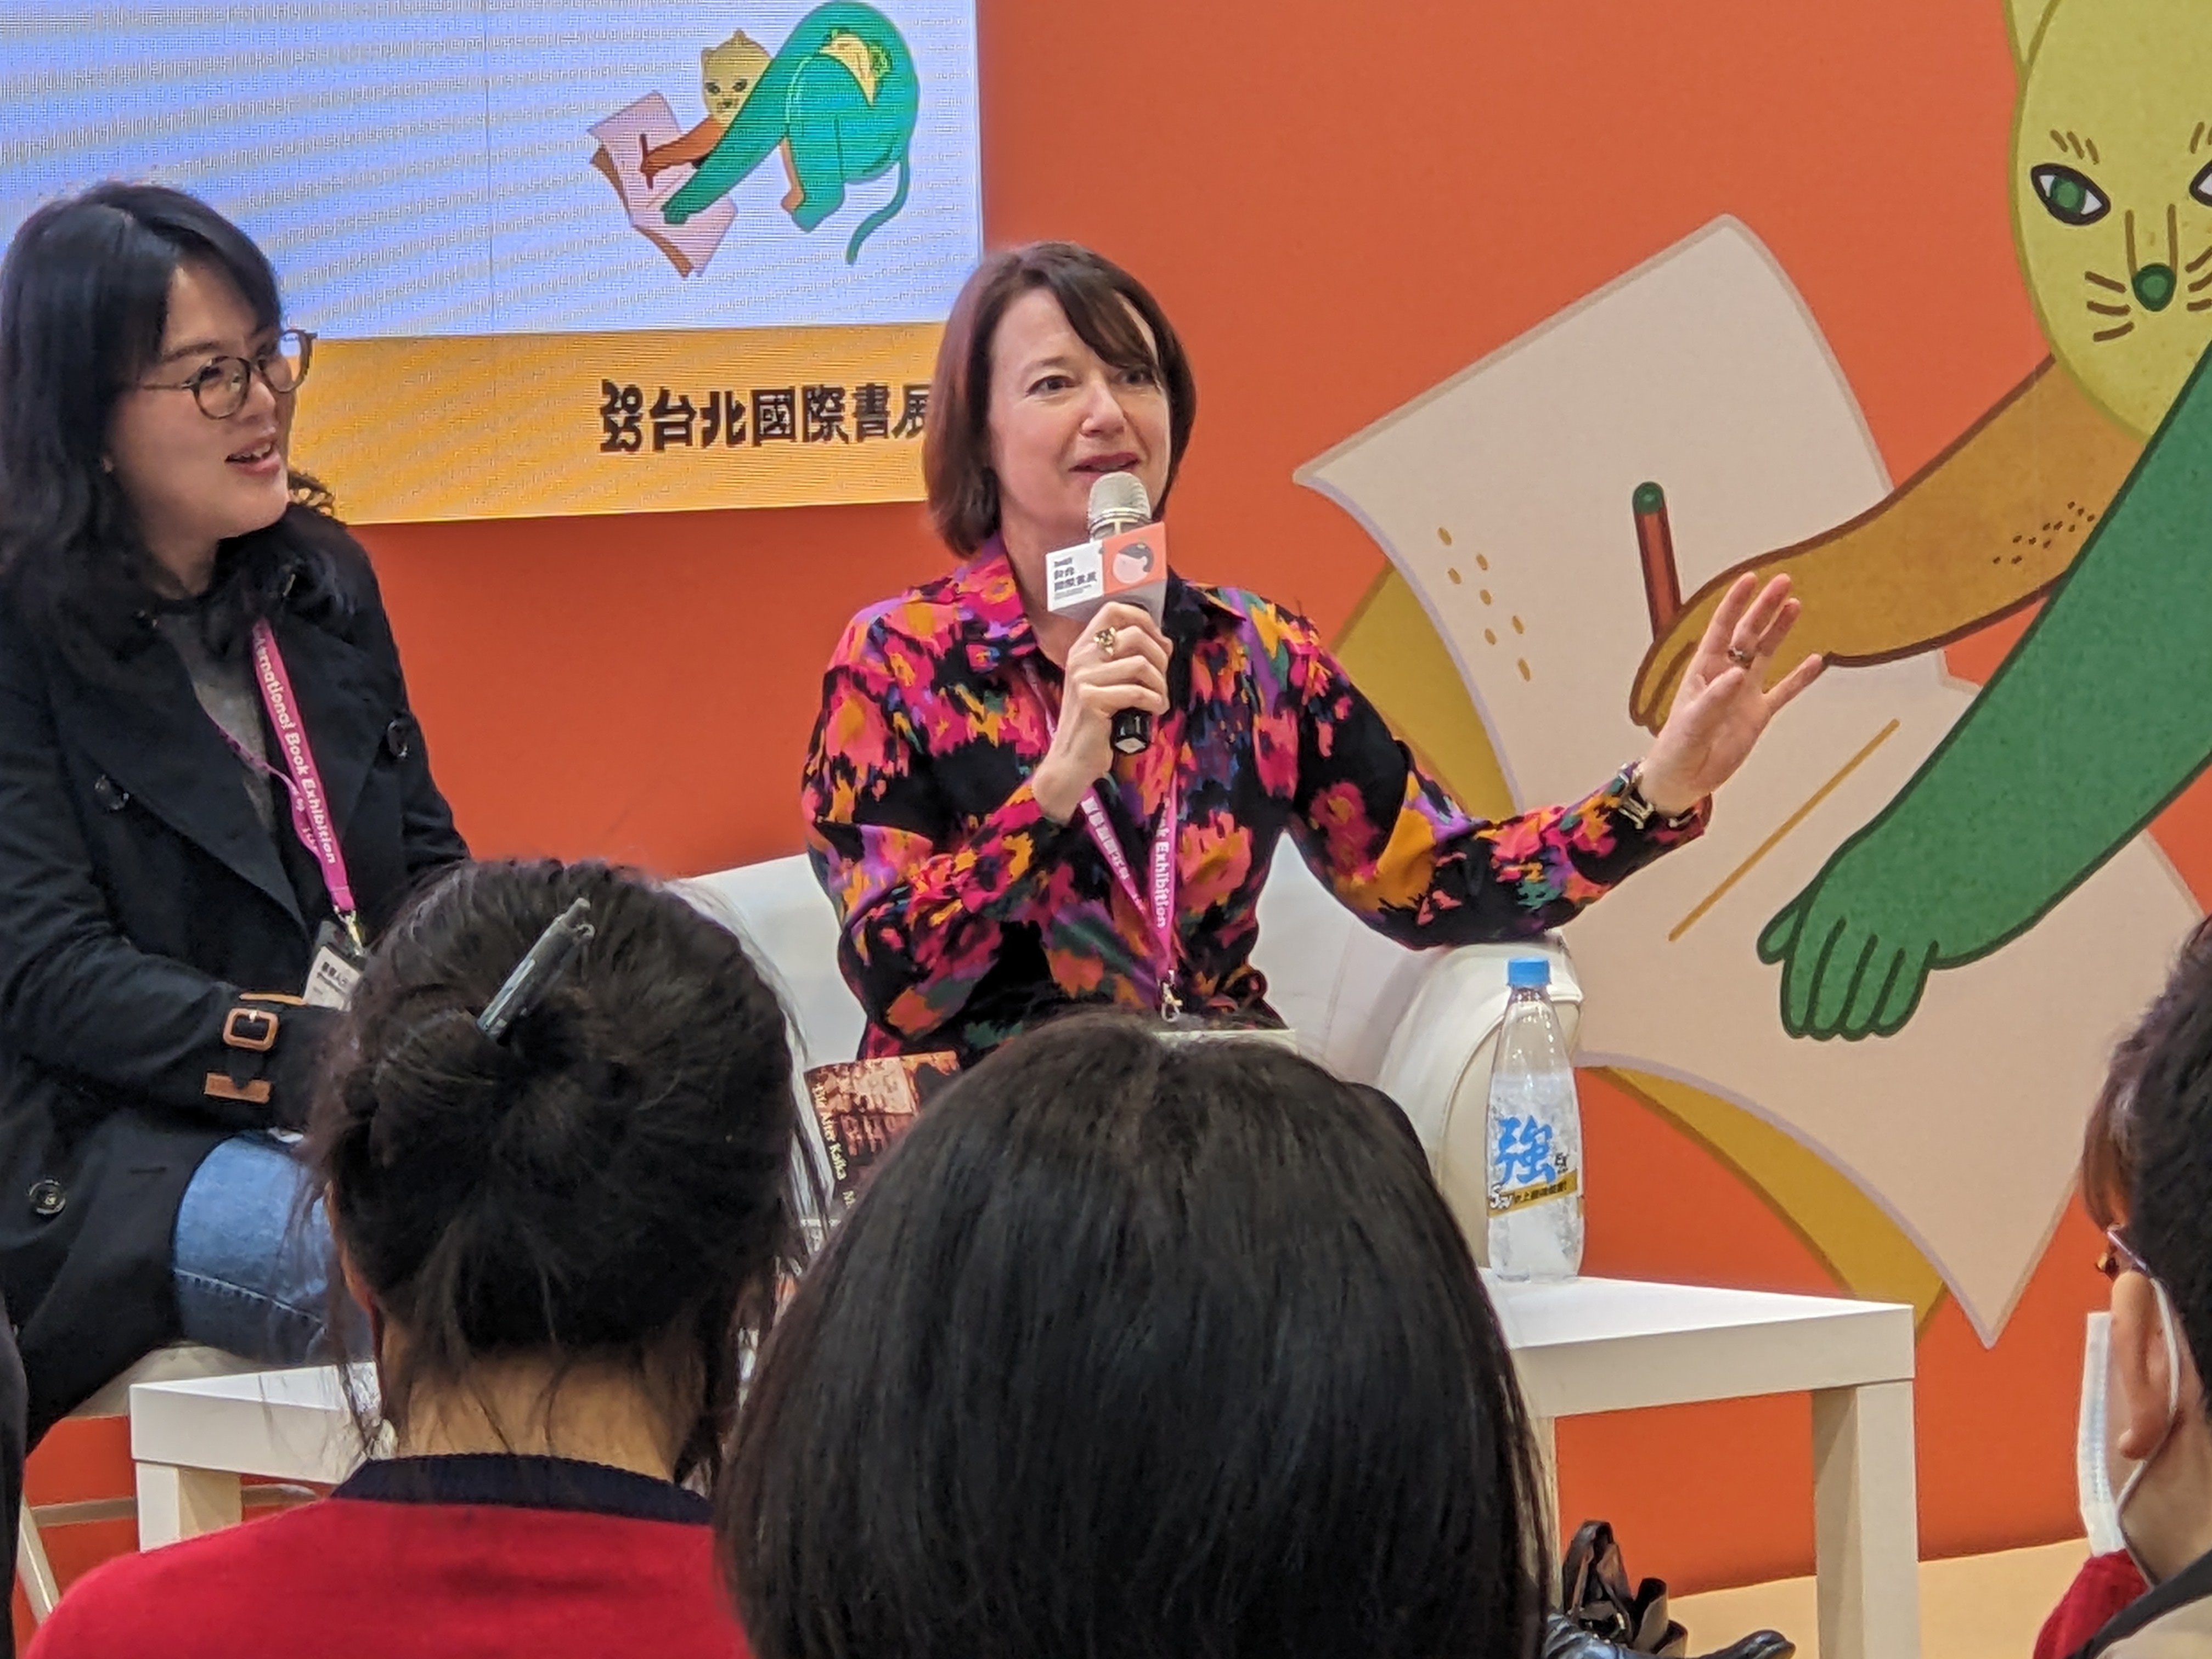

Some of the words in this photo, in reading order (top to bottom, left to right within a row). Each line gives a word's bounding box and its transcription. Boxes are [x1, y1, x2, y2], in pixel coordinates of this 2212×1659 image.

[285, 731, 309, 776] Book
[301, 778, 336, 864] Exhibition
[1155, 842, 1170, 929] Exhibition
[830, 1142, 847, 1181] Kafka
[1496, 1115, 1556, 1184] 強
